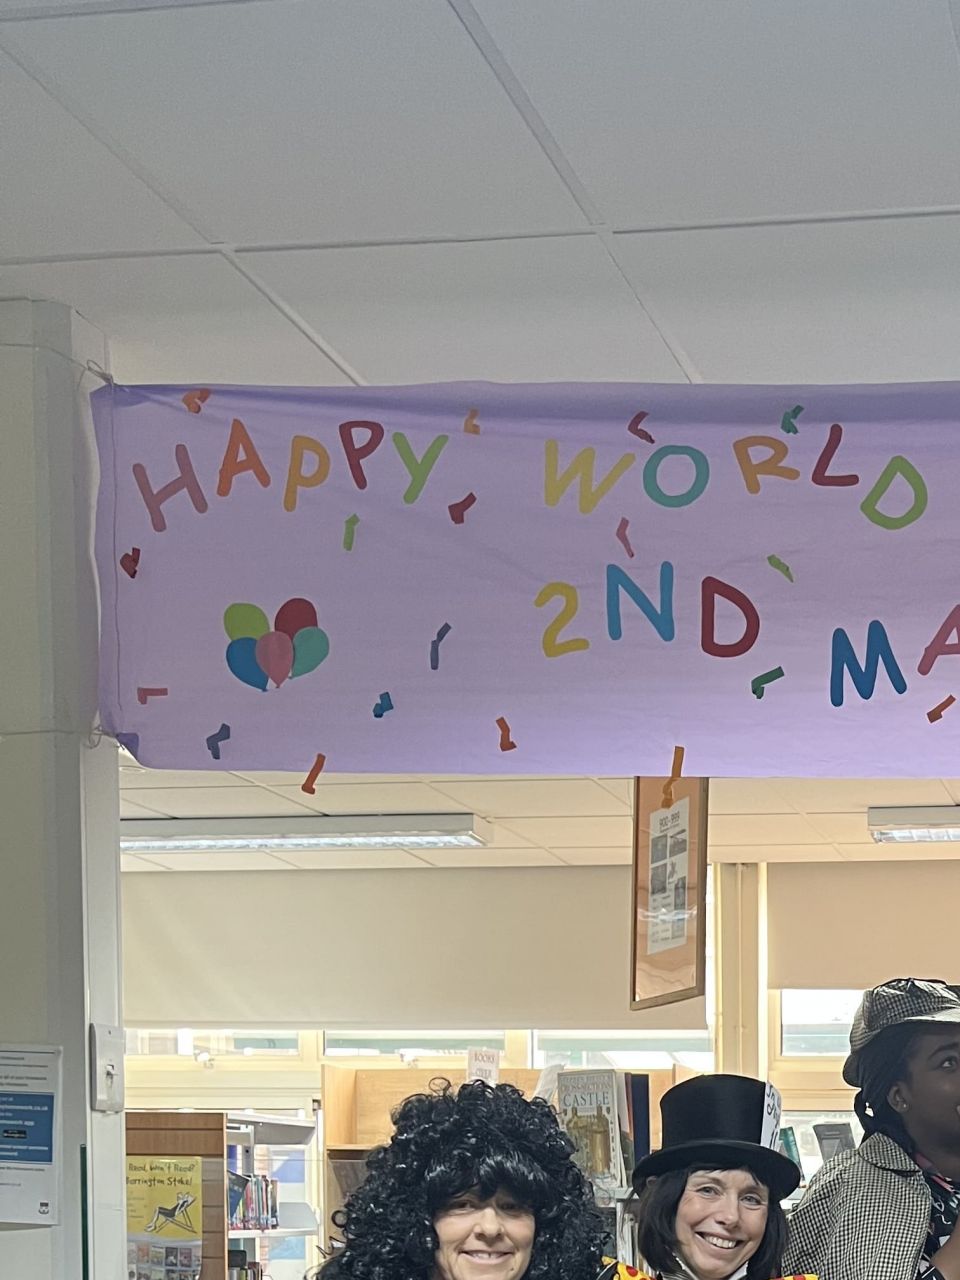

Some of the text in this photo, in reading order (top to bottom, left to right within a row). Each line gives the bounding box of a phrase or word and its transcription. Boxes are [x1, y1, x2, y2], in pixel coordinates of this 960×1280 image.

[132, 418, 449, 532] HAPPY
[544, 424, 928, 531] WORLD
[534, 561, 760, 660] 2ND
[563, 1091, 610, 1108] CASTLE
